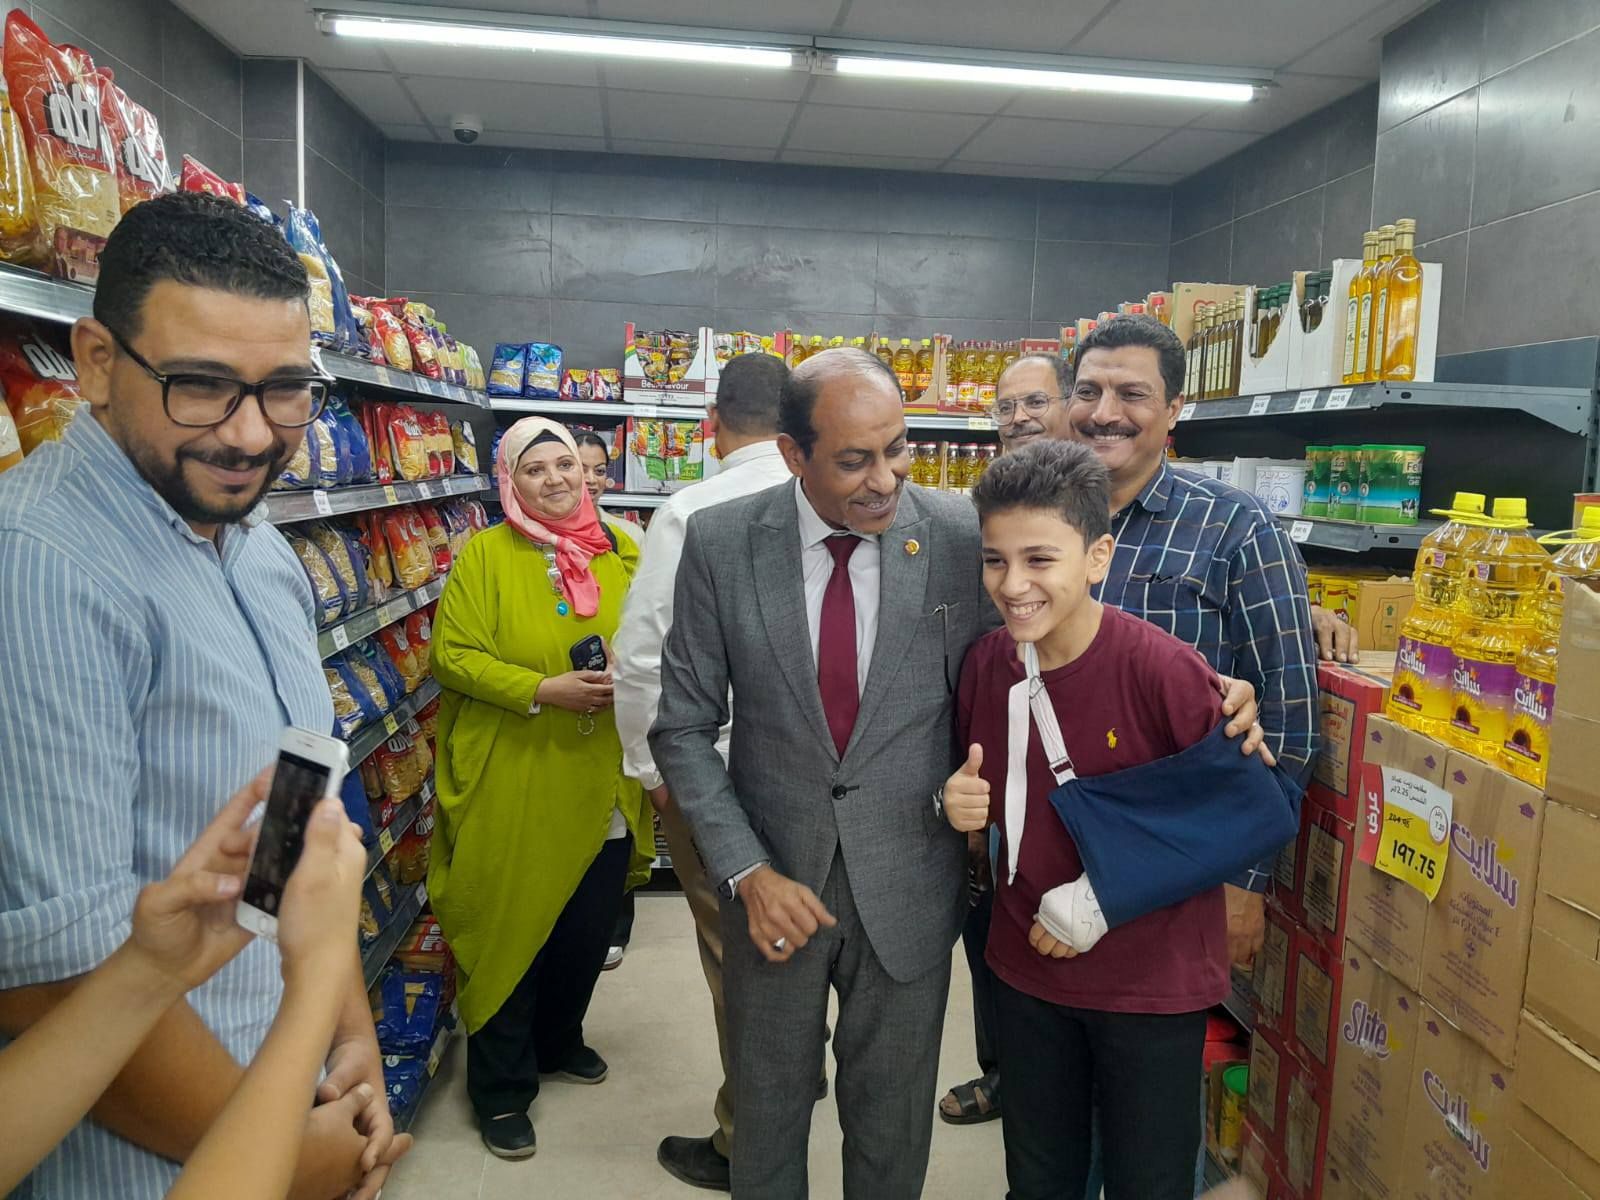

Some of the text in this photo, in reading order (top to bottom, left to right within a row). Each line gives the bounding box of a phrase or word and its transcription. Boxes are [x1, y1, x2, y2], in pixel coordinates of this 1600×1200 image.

[1367, 791, 1381, 834] عرض
[1391, 839, 1437, 880] 197.75
[1450, 821, 1518, 909] سلايت
[1343, 999, 1390, 1060] Slite
